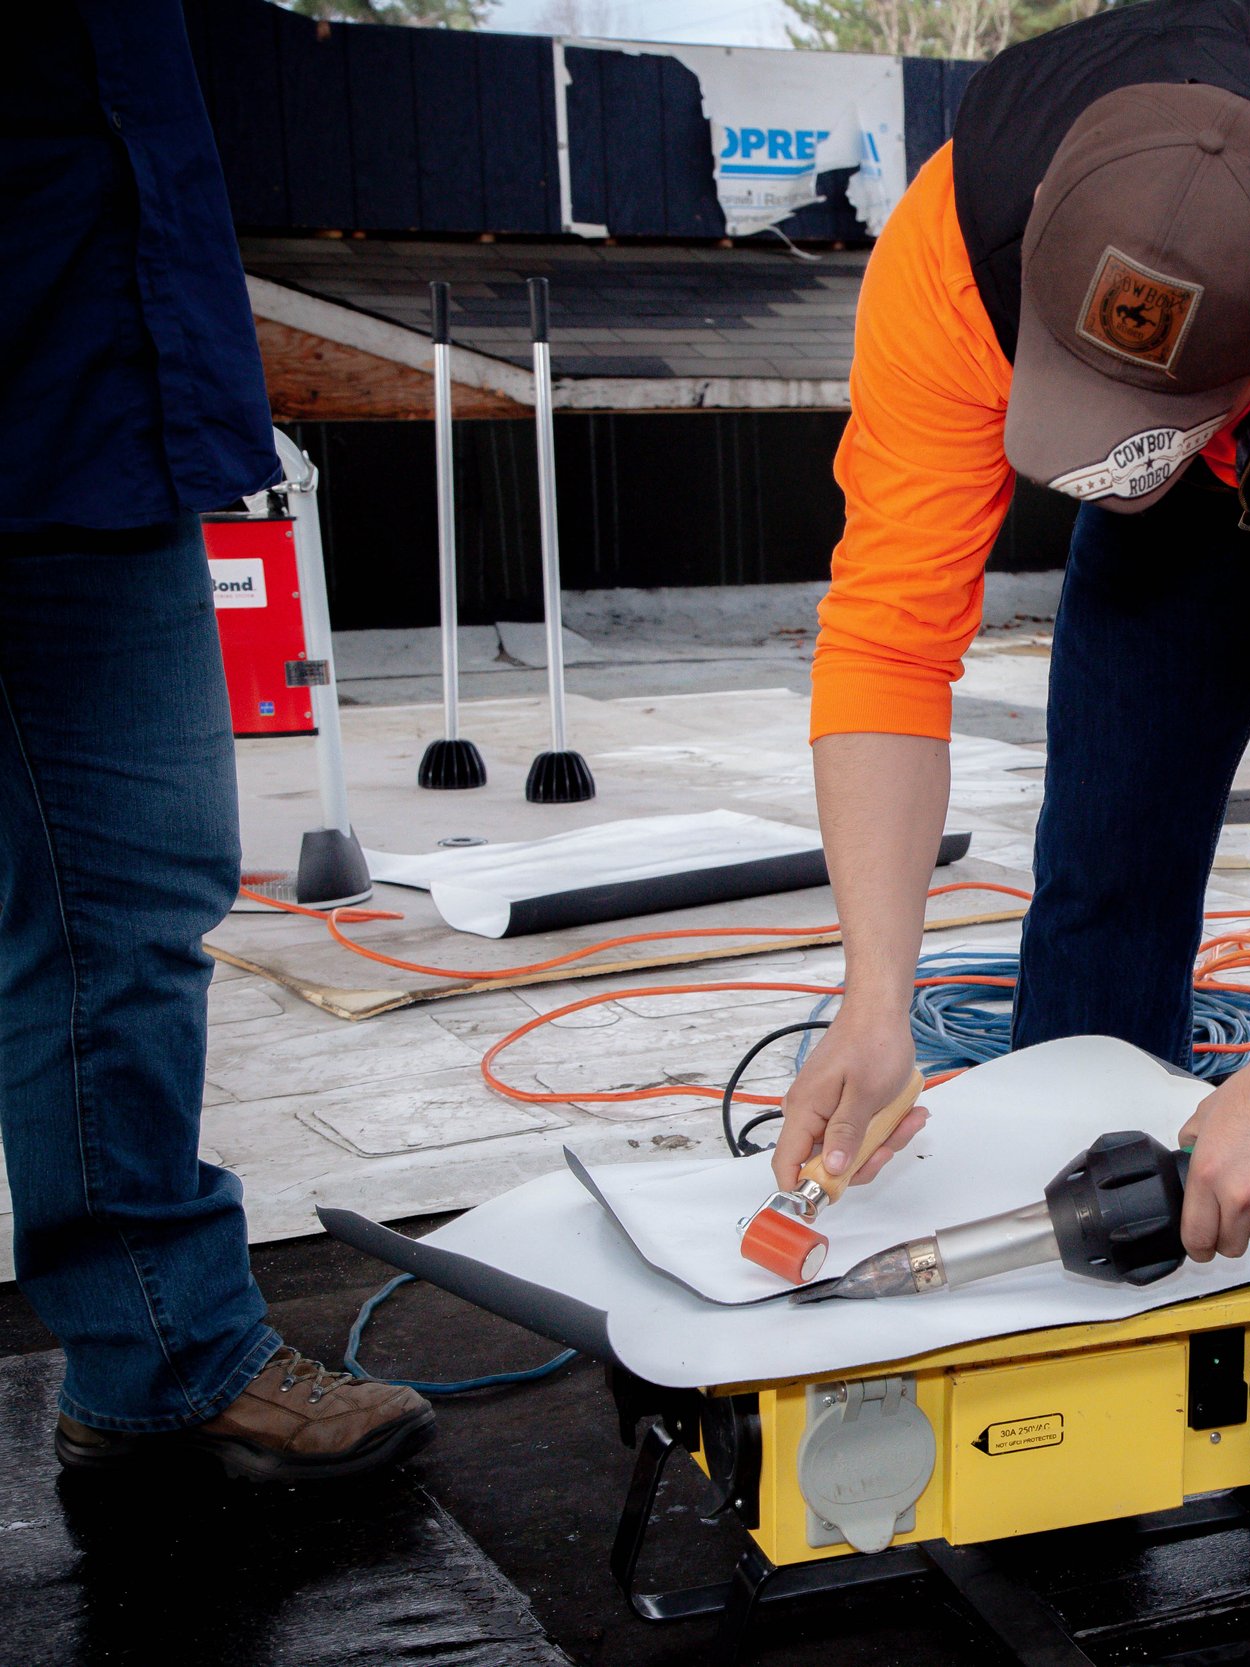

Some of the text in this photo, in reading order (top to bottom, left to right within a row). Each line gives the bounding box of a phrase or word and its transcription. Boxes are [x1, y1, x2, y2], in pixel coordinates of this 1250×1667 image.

[1113, 431, 1177, 469] COWBOY
[1129, 463, 1171, 496] RODEO
[995, 1441, 1007, 1449] NOT
[1022, 1434, 1057, 1445] PROTECTED
[1000, 1428, 1016, 1438] 30A
